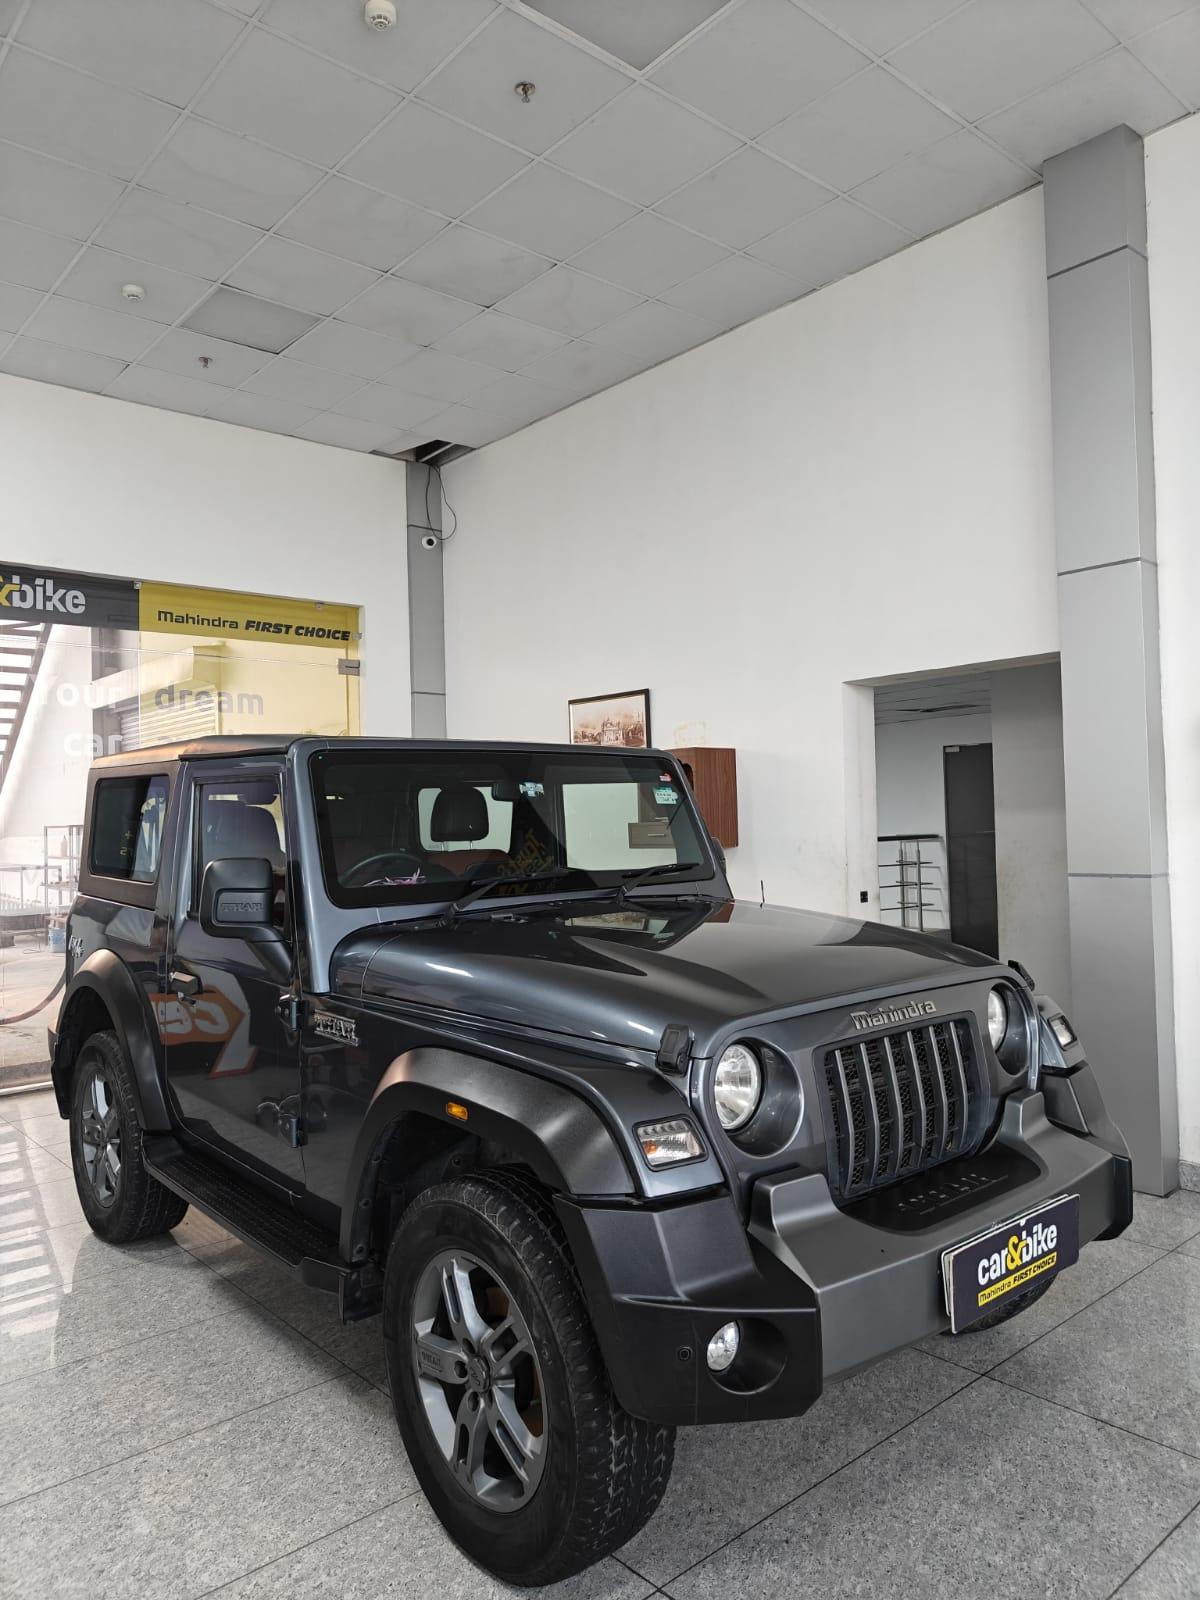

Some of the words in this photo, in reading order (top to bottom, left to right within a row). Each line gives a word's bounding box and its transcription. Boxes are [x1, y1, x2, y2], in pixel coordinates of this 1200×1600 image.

[157, 610, 239, 630] Mahindra
[244, 619, 293, 635] FIRST
[294, 625, 351, 641] CHOICE
[155, 680, 264, 716] dream
[63, 733, 124, 759] car
[850, 1000, 937, 1031] Mahindra
[977, 1222, 1058, 1286] car&bike
[979, 1280, 1012, 1302] Mahindra
[1013, 1267, 1032, 1285] FIRST
[1032, 1254, 1056, 1274] CHOICE
